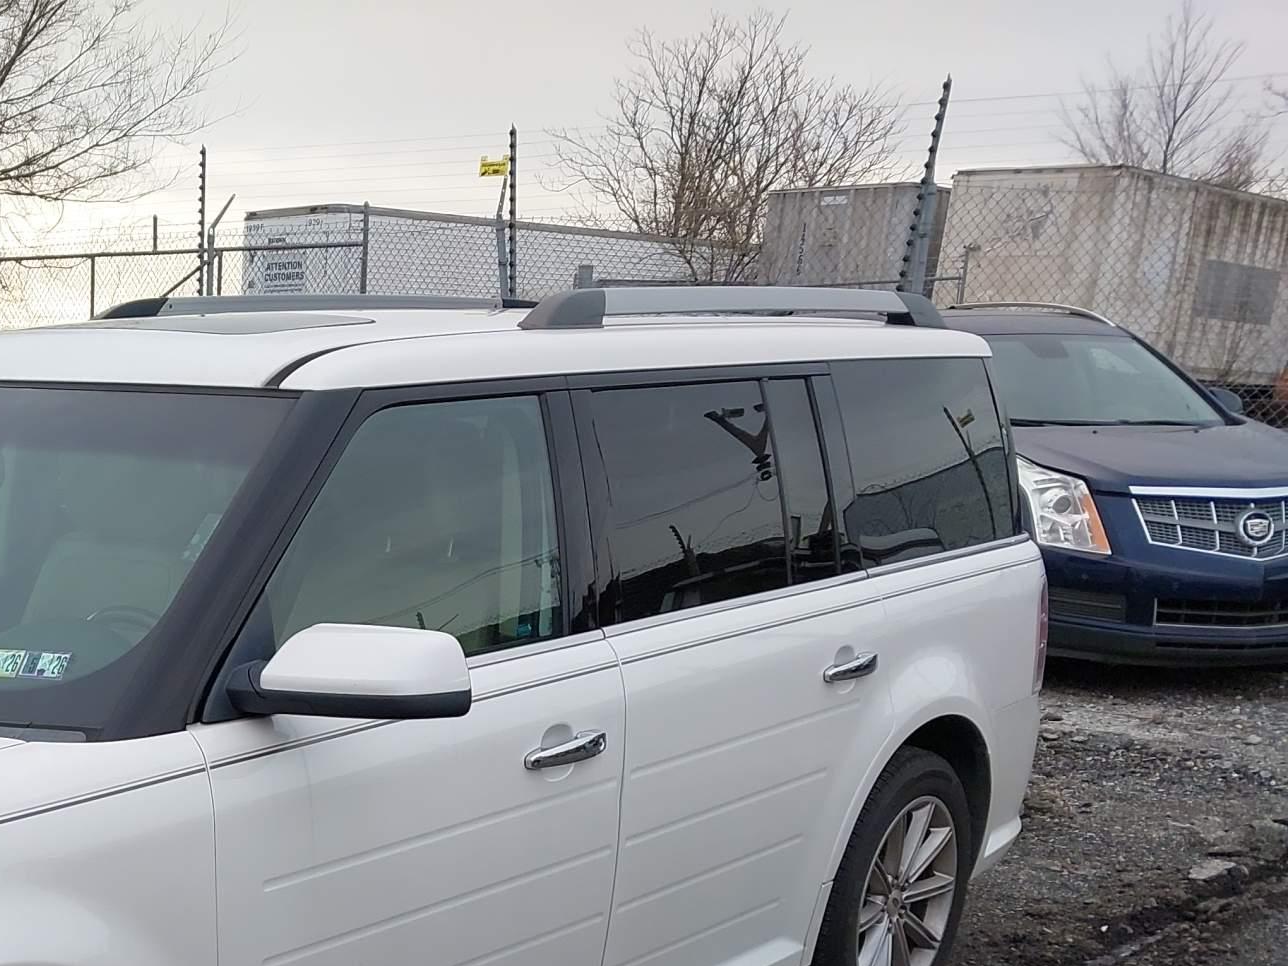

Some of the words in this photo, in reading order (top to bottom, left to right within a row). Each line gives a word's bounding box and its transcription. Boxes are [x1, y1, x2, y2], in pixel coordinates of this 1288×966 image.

[266, 261, 303, 271] ATTENTION
[264, 271, 305, 282] CUSTOMERS
[5, 653, 22, 673] 26
[51, 655, 68, 675] 26
